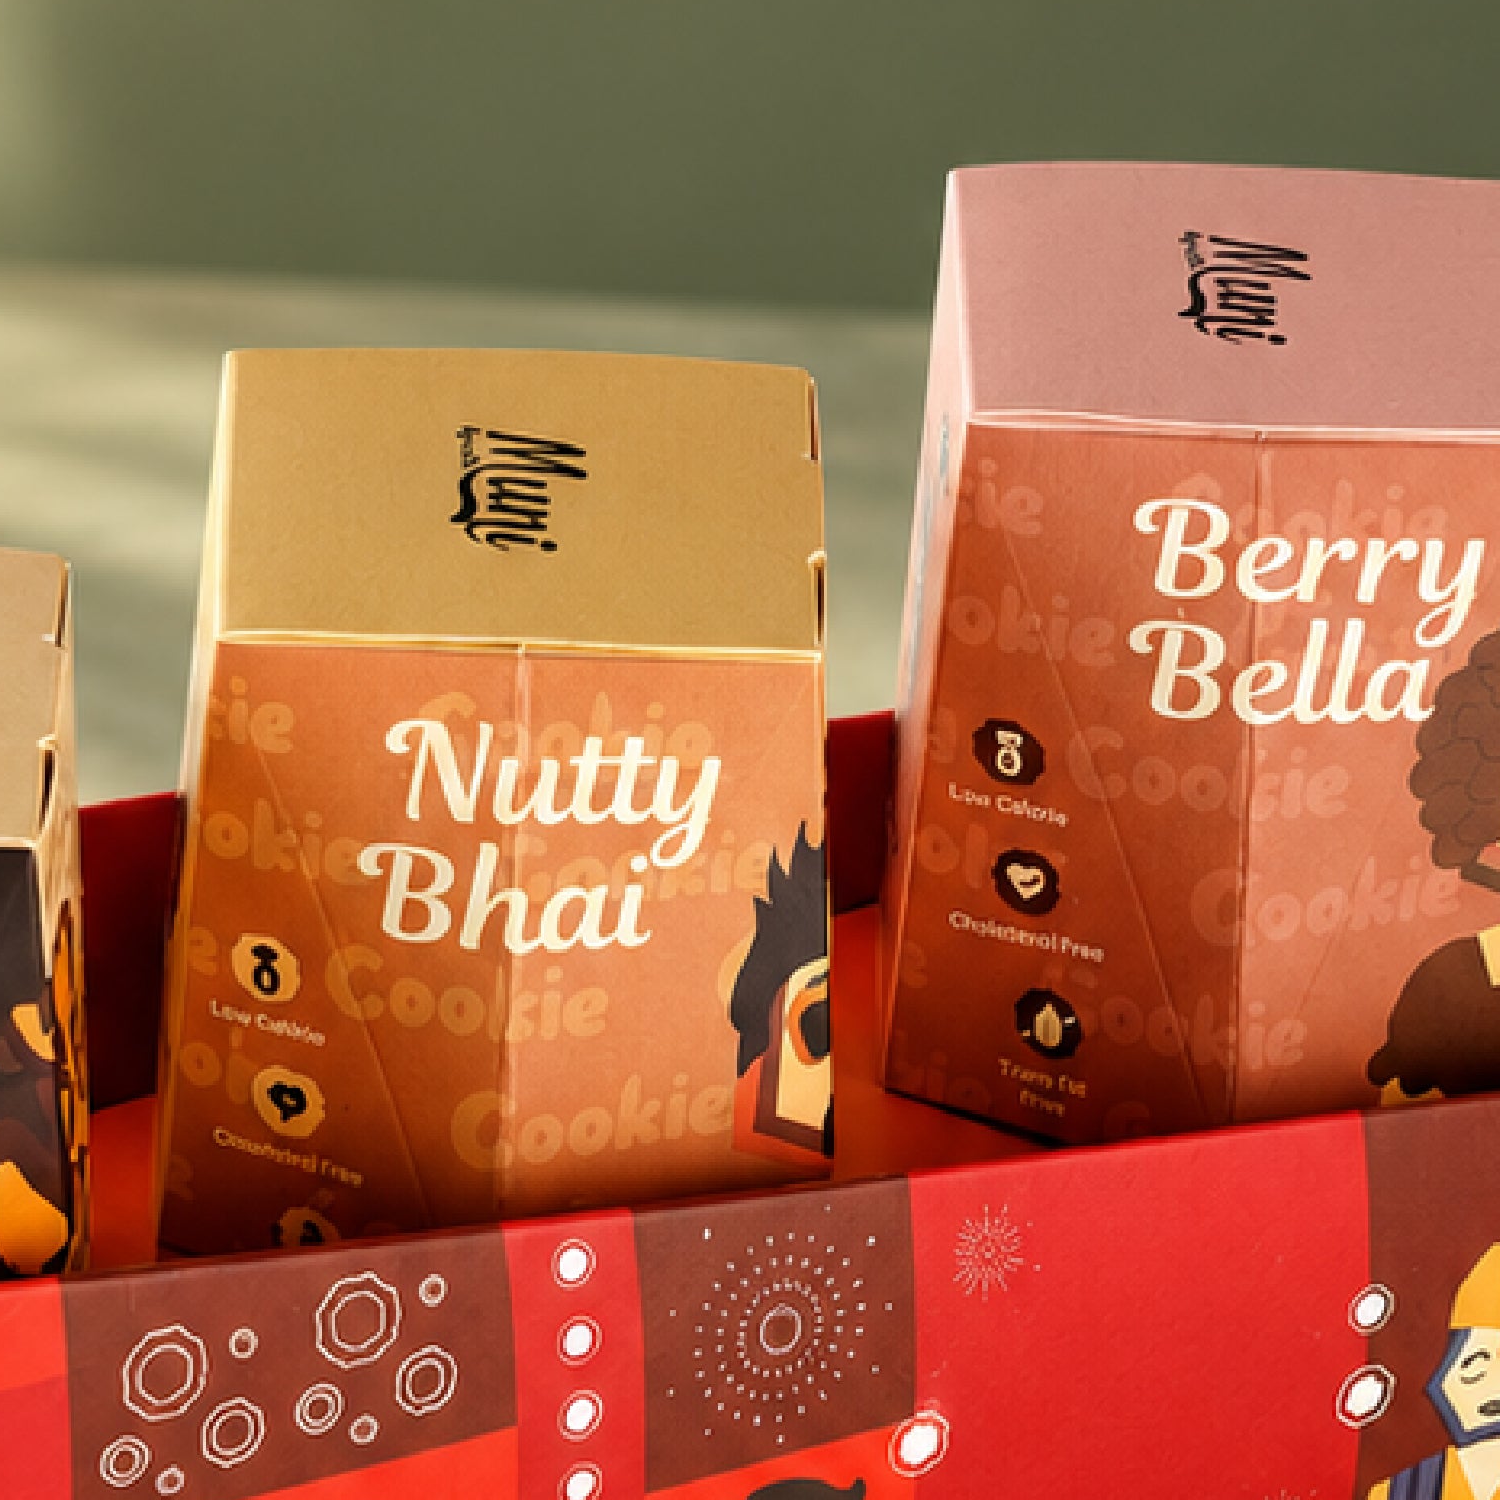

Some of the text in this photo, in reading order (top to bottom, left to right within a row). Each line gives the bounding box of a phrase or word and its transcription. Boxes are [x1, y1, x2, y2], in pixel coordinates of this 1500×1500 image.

[1178, 235, 1312, 346] Muni
[450, 429, 587, 553] Muni
[1133, 498, 1486, 648] Berry
[1128, 617, 1434, 725] Bella
[386, 717, 721, 869] Nutty
[357, 842, 651, 956] Bhai
